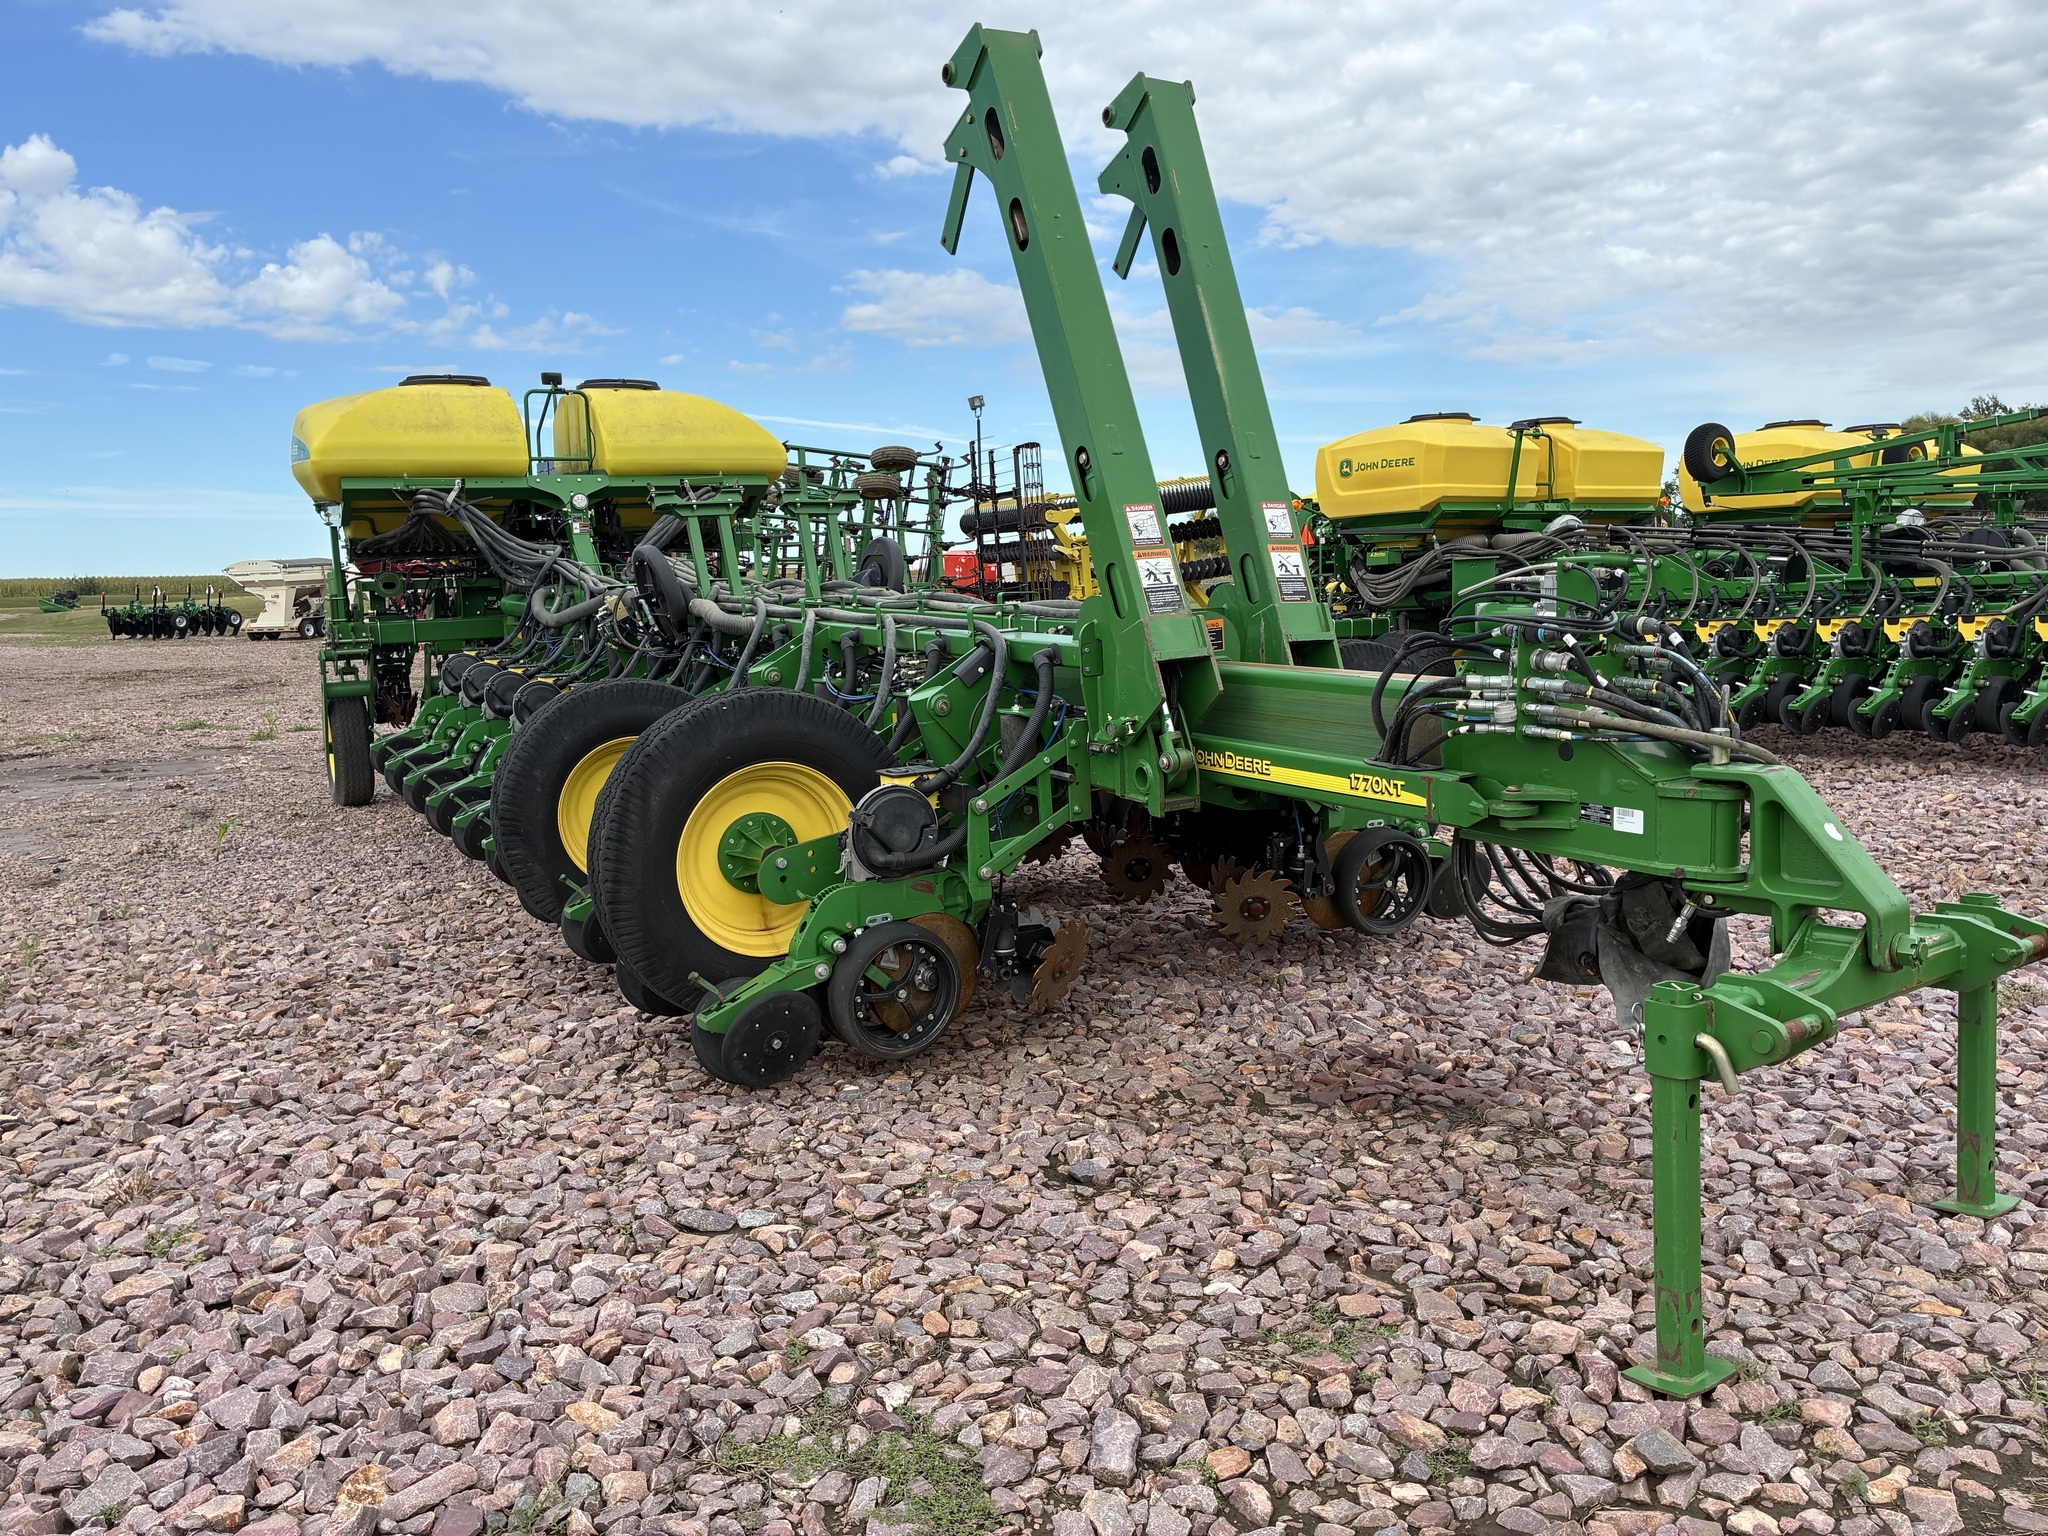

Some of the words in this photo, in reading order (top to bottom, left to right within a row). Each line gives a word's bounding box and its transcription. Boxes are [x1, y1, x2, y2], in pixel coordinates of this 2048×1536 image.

[1354, 461, 1379, 472] JOHN
[1381, 457, 1415, 469] DEERE
[1224, 751, 1272, 775] DEERE
[1349, 772, 1406, 797] 1770NT
